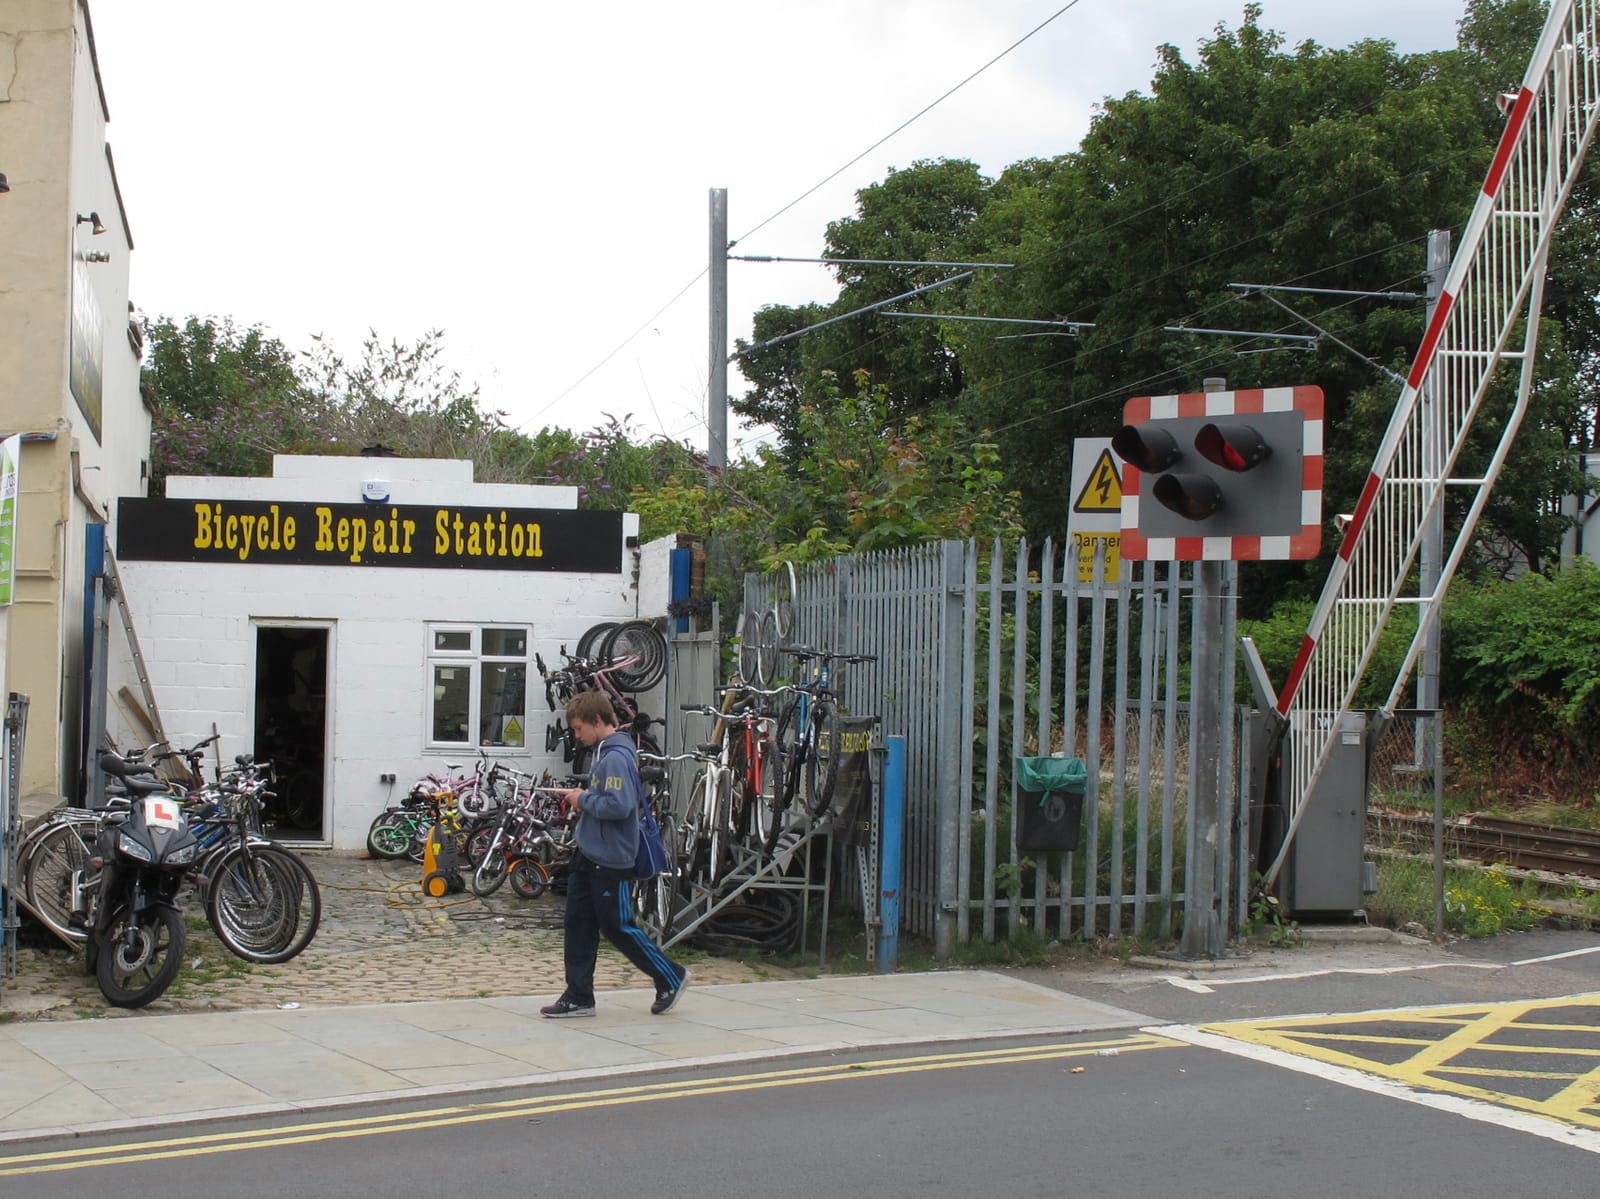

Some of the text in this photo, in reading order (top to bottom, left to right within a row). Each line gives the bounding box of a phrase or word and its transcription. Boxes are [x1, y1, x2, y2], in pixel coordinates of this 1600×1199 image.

[194, 503, 543, 562] Bicycle Repair Station
[154, 803, 173, 821] L
